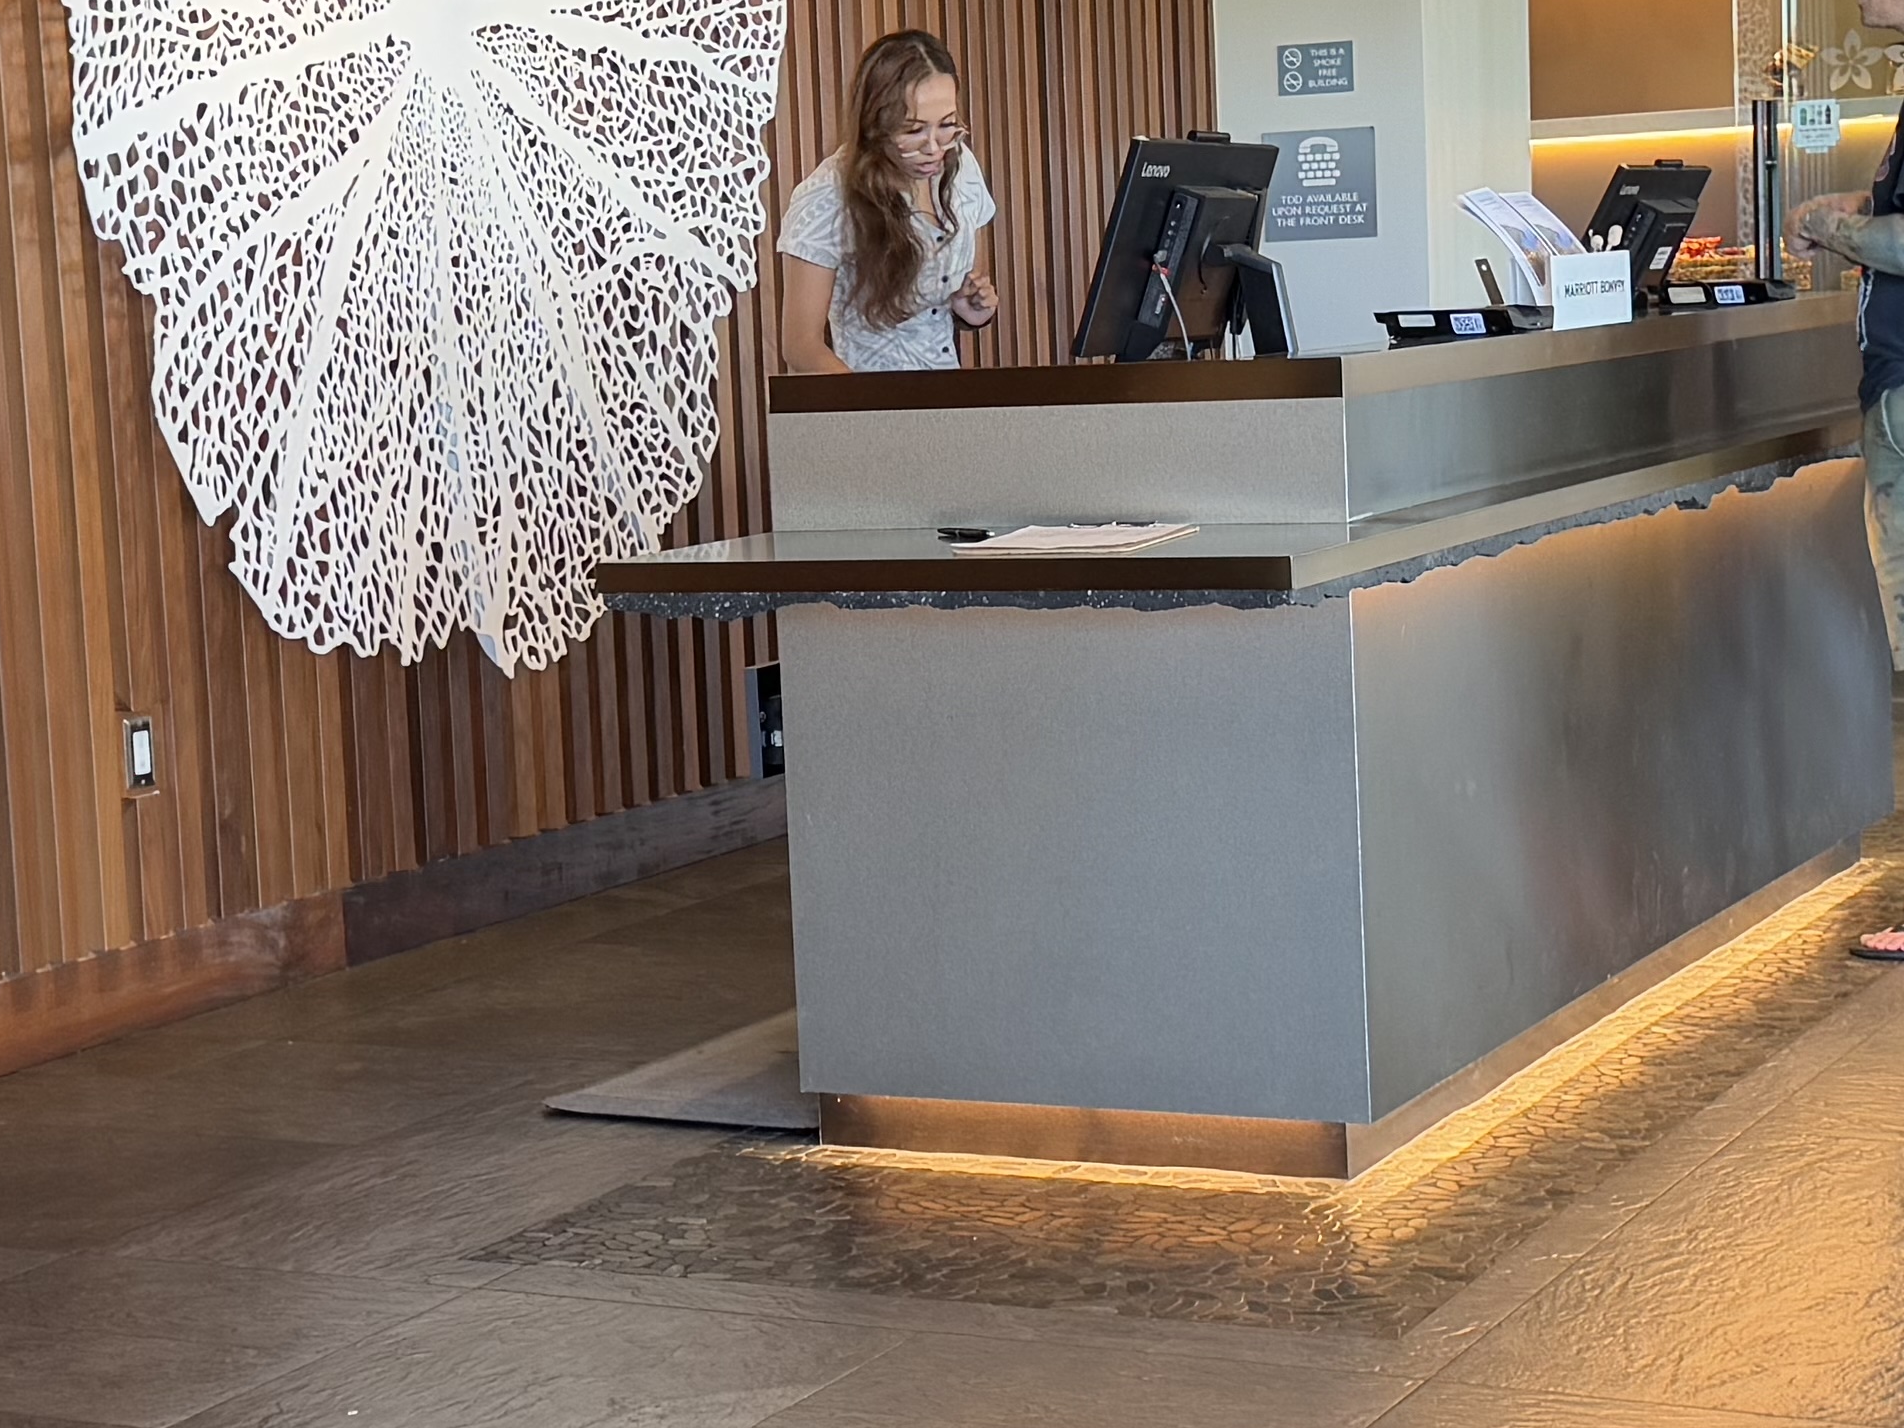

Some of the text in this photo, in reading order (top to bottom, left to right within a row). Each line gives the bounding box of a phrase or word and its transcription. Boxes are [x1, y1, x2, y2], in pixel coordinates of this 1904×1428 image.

[1313, 58, 1342, 67] SMOKE
[1308, 77, 1349, 88] BUILDING
[1141, 162, 1171, 178] Lenovo
[1281, 192, 1359, 205] TDD AVAILABLE
[1272, 203, 1368, 216] UPON REQUEST AT
[1276, 214, 1365, 227] THE FRONT DESK
[1564, 280, 1599, 298] MARRIOTT
